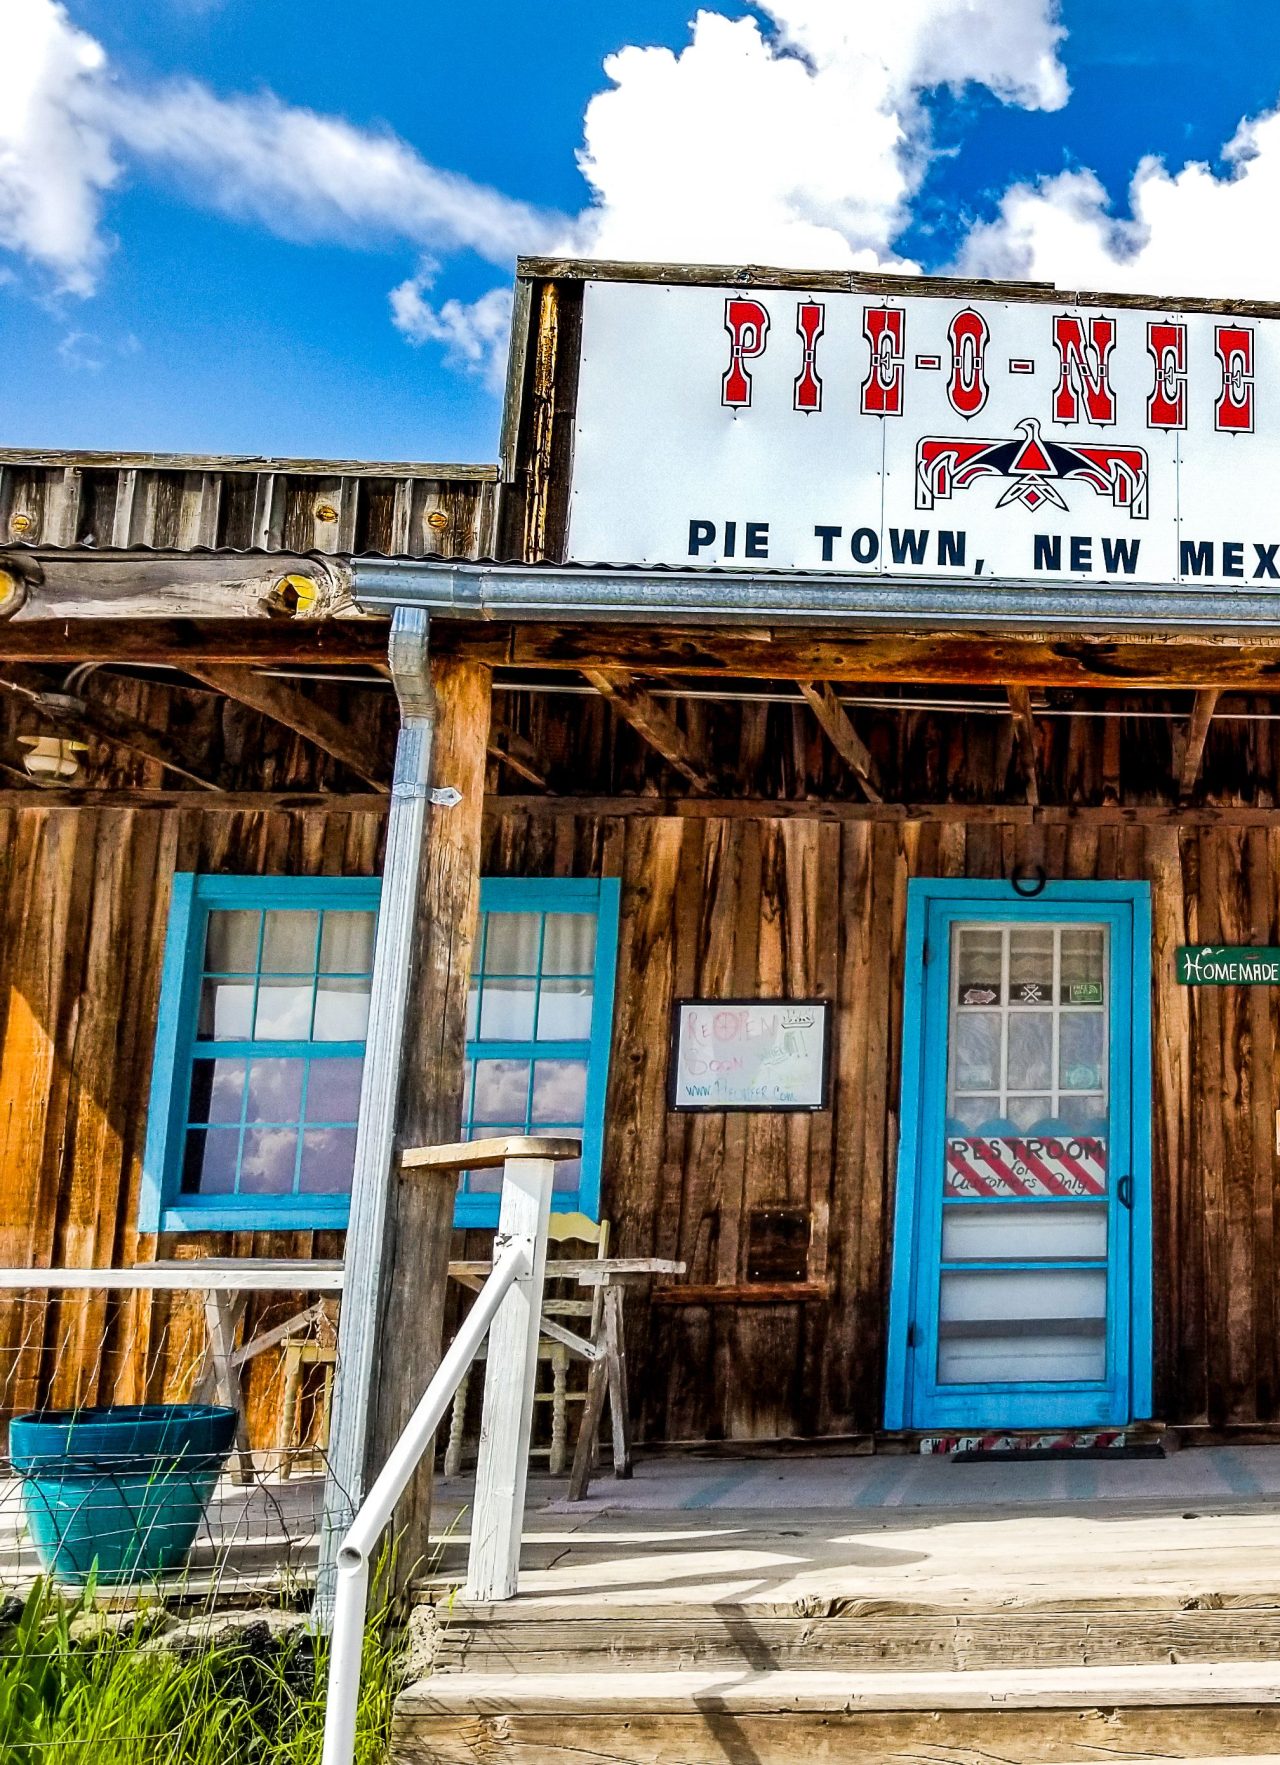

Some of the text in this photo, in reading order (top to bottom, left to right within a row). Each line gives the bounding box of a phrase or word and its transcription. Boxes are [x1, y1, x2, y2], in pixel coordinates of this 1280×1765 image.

[688, 519, 769, 559] PIE
[814, 525, 985, 575] TOWN,
[1034, 534, 1141, 574] NEW
[1184, 953, 1279, 981] HOMEMADE
[952, 1139, 1105, 1161] RESTROOM
[1012, 1159, 1030, 1176] for
[952, 1171, 1088, 1195] Customers Only
